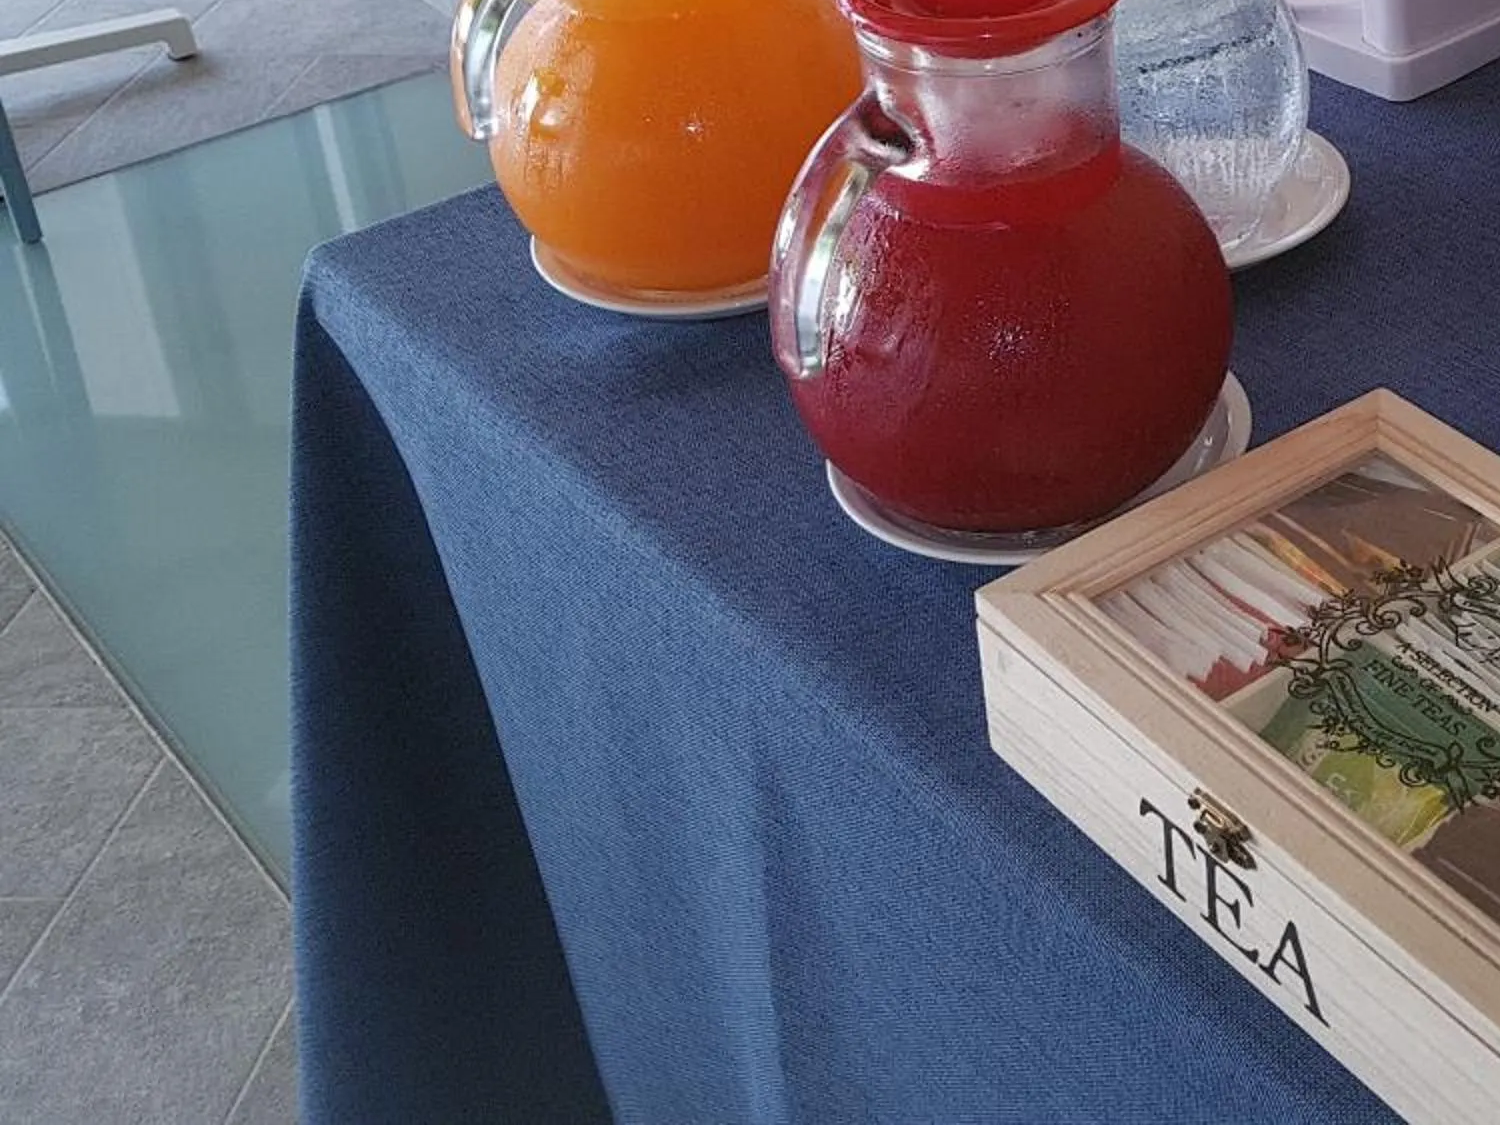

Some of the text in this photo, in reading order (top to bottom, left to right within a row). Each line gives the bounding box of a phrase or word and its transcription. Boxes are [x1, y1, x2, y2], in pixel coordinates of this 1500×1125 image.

[1362, 659, 1416, 701] FINE
[1412, 693, 1467, 736] TEAS
[1411, 650, 1499, 713] SELECTION
[1139, 797, 1331, 1028] TEA
